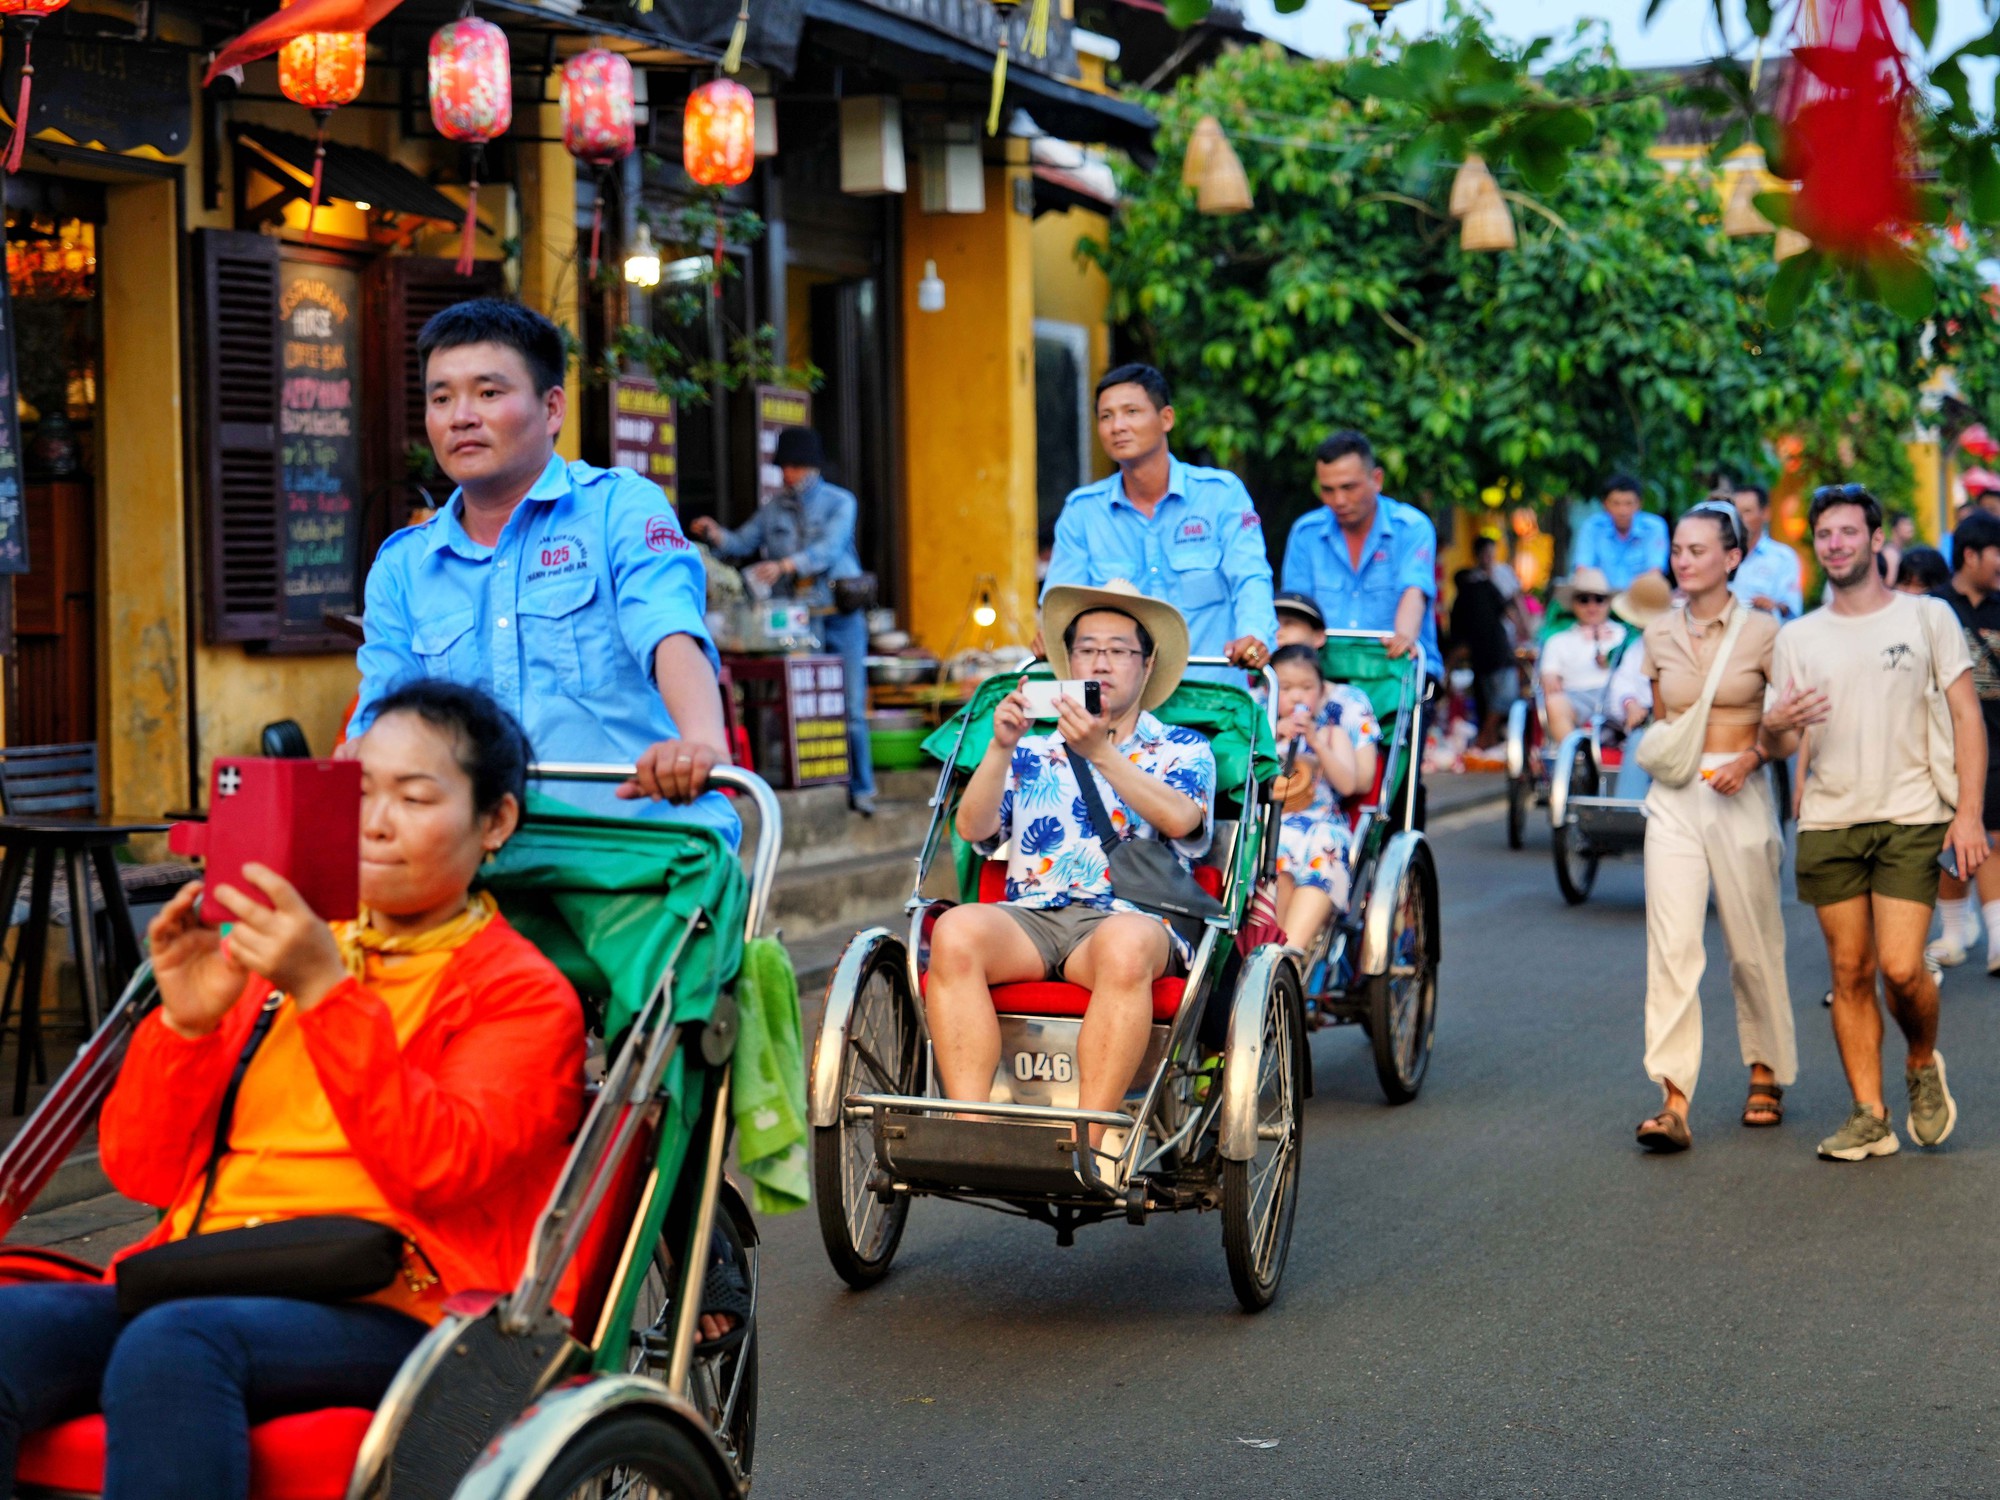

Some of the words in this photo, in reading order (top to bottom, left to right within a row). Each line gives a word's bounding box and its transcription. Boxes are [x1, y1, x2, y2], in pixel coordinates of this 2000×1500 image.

[541, 545, 570, 566] 025
[577, 561, 587, 569] AN
[1014, 1052, 1072, 1082] 046
